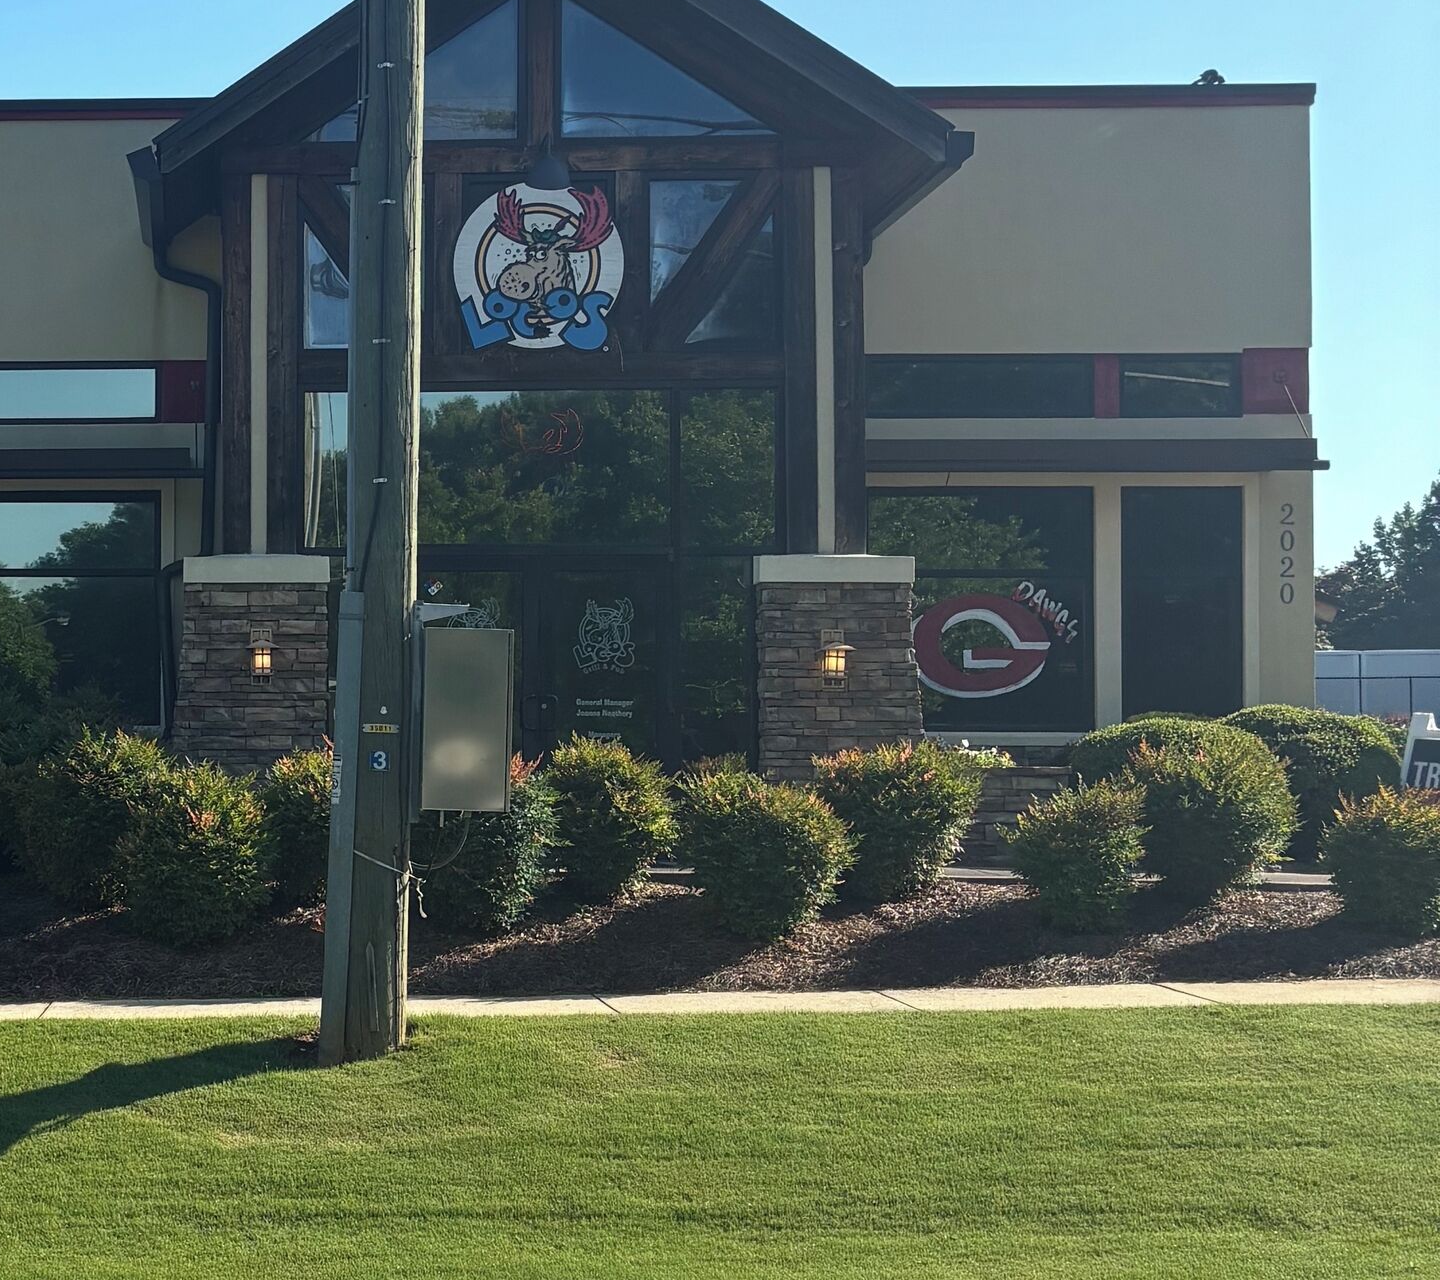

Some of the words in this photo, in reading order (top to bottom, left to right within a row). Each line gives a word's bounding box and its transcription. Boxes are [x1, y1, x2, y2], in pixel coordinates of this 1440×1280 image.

[1279, 503, 1295, 604] 2020
[911, 592, 1051, 698] G
[1012, 580, 1078, 644] DAWGS
[373, 751, 386, 770] 3
